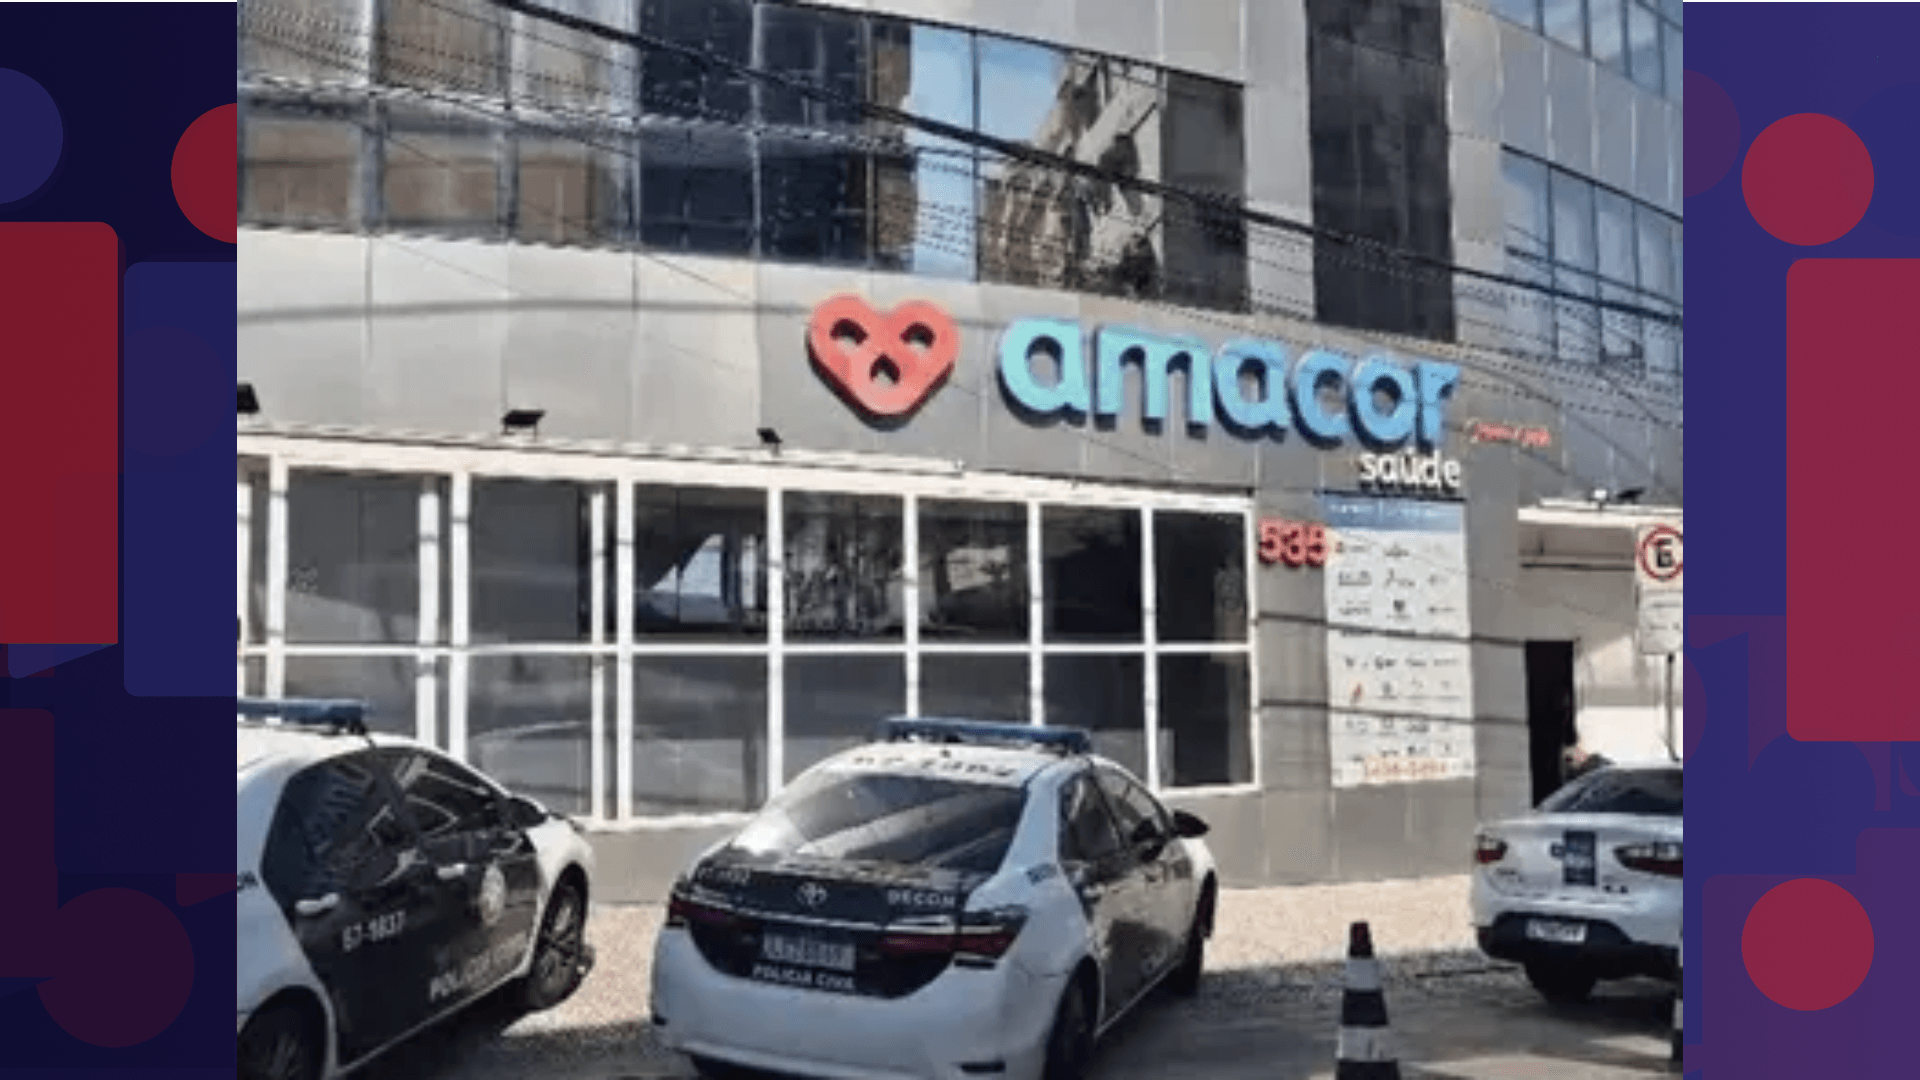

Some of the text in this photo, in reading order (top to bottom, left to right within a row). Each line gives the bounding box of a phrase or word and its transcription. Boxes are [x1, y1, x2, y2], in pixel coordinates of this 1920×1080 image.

[998, 316, 1460, 448] amacor
[1358, 446, 1462, 489] saúde
[1257, 517, 1329, 567] 535
